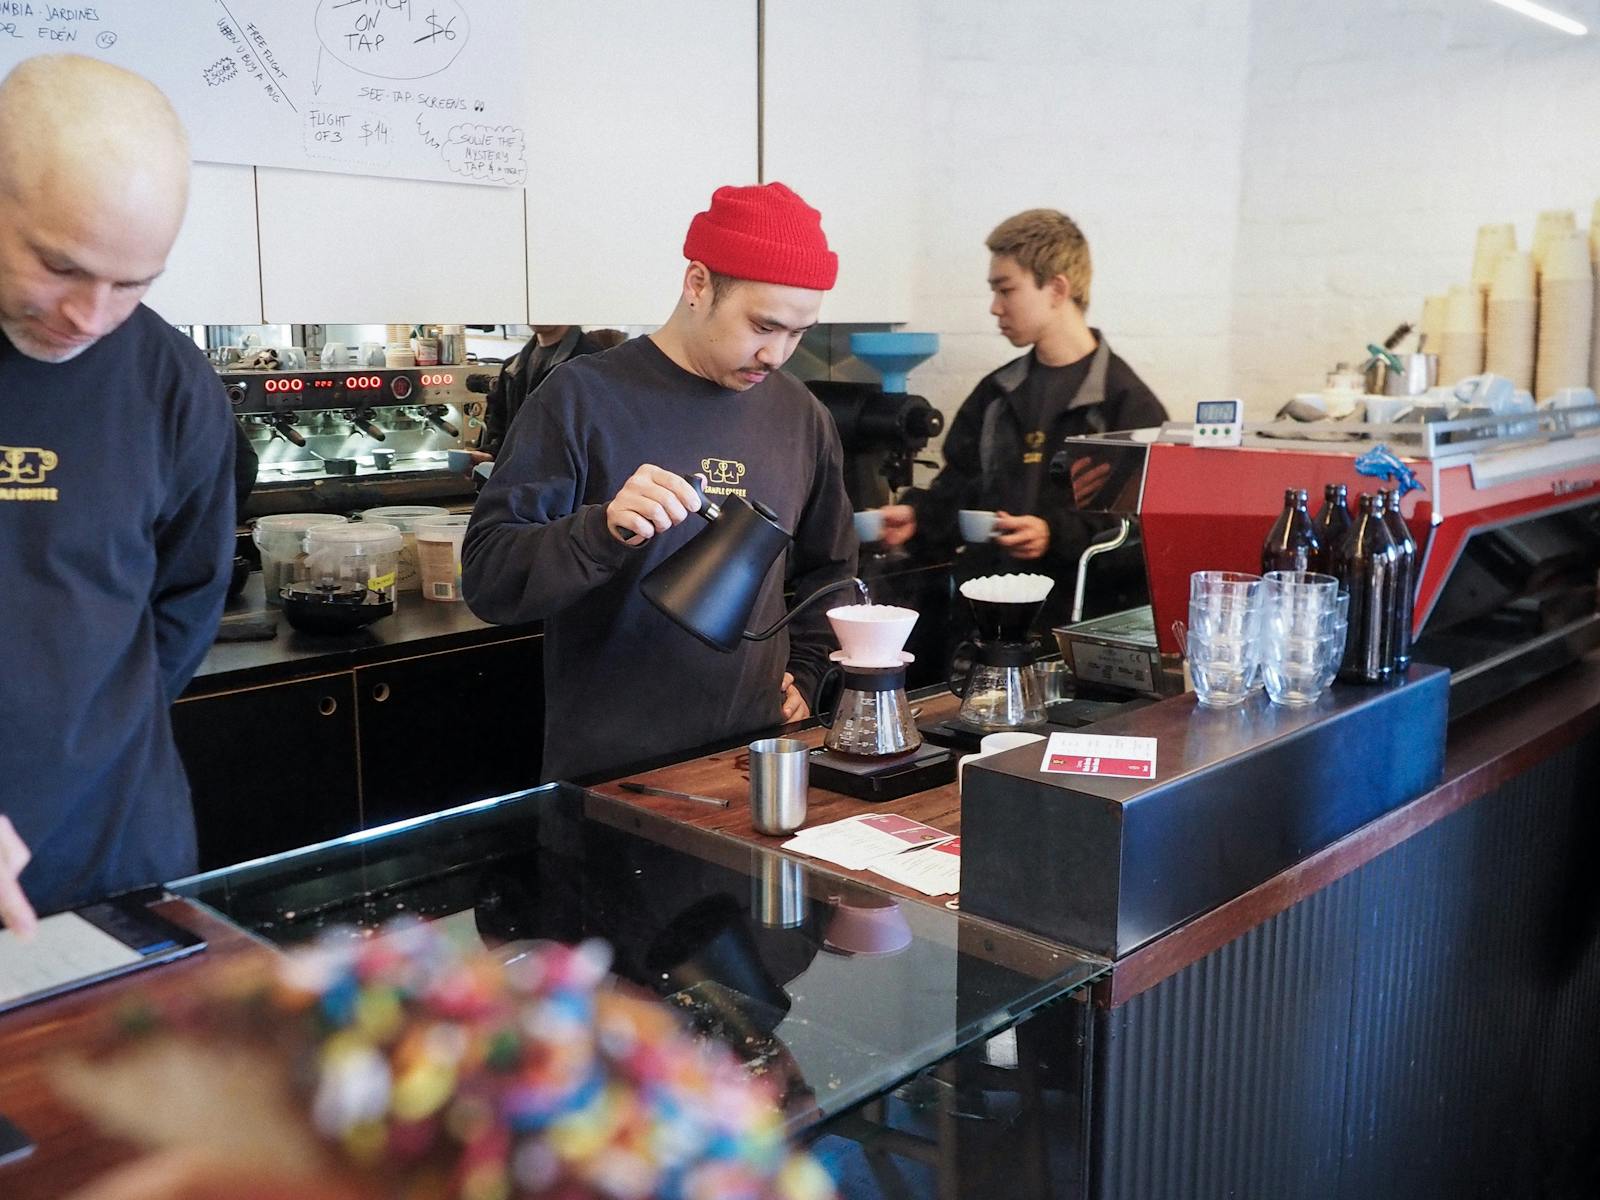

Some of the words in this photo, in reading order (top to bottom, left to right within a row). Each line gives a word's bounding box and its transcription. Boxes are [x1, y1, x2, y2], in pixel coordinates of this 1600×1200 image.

[46, 4, 100, 21] JARDINES
[355, 9, 380, 32] ON
[413, 8, 456, 44] $6
[246, 22, 267, 48] FREE
[263, 48, 288, 79] FLIGHT
[344, 33, 384, 52] TAP
[357, 86, 385, 102] SEE
[392, 90, 412, 103] TAP
[418, 93, 468, 111] SCREENS
[309, 109, 352, 128] FLIGHT
[315, 130, 331, 141] OF
[330, 131, 343, 143] 3
